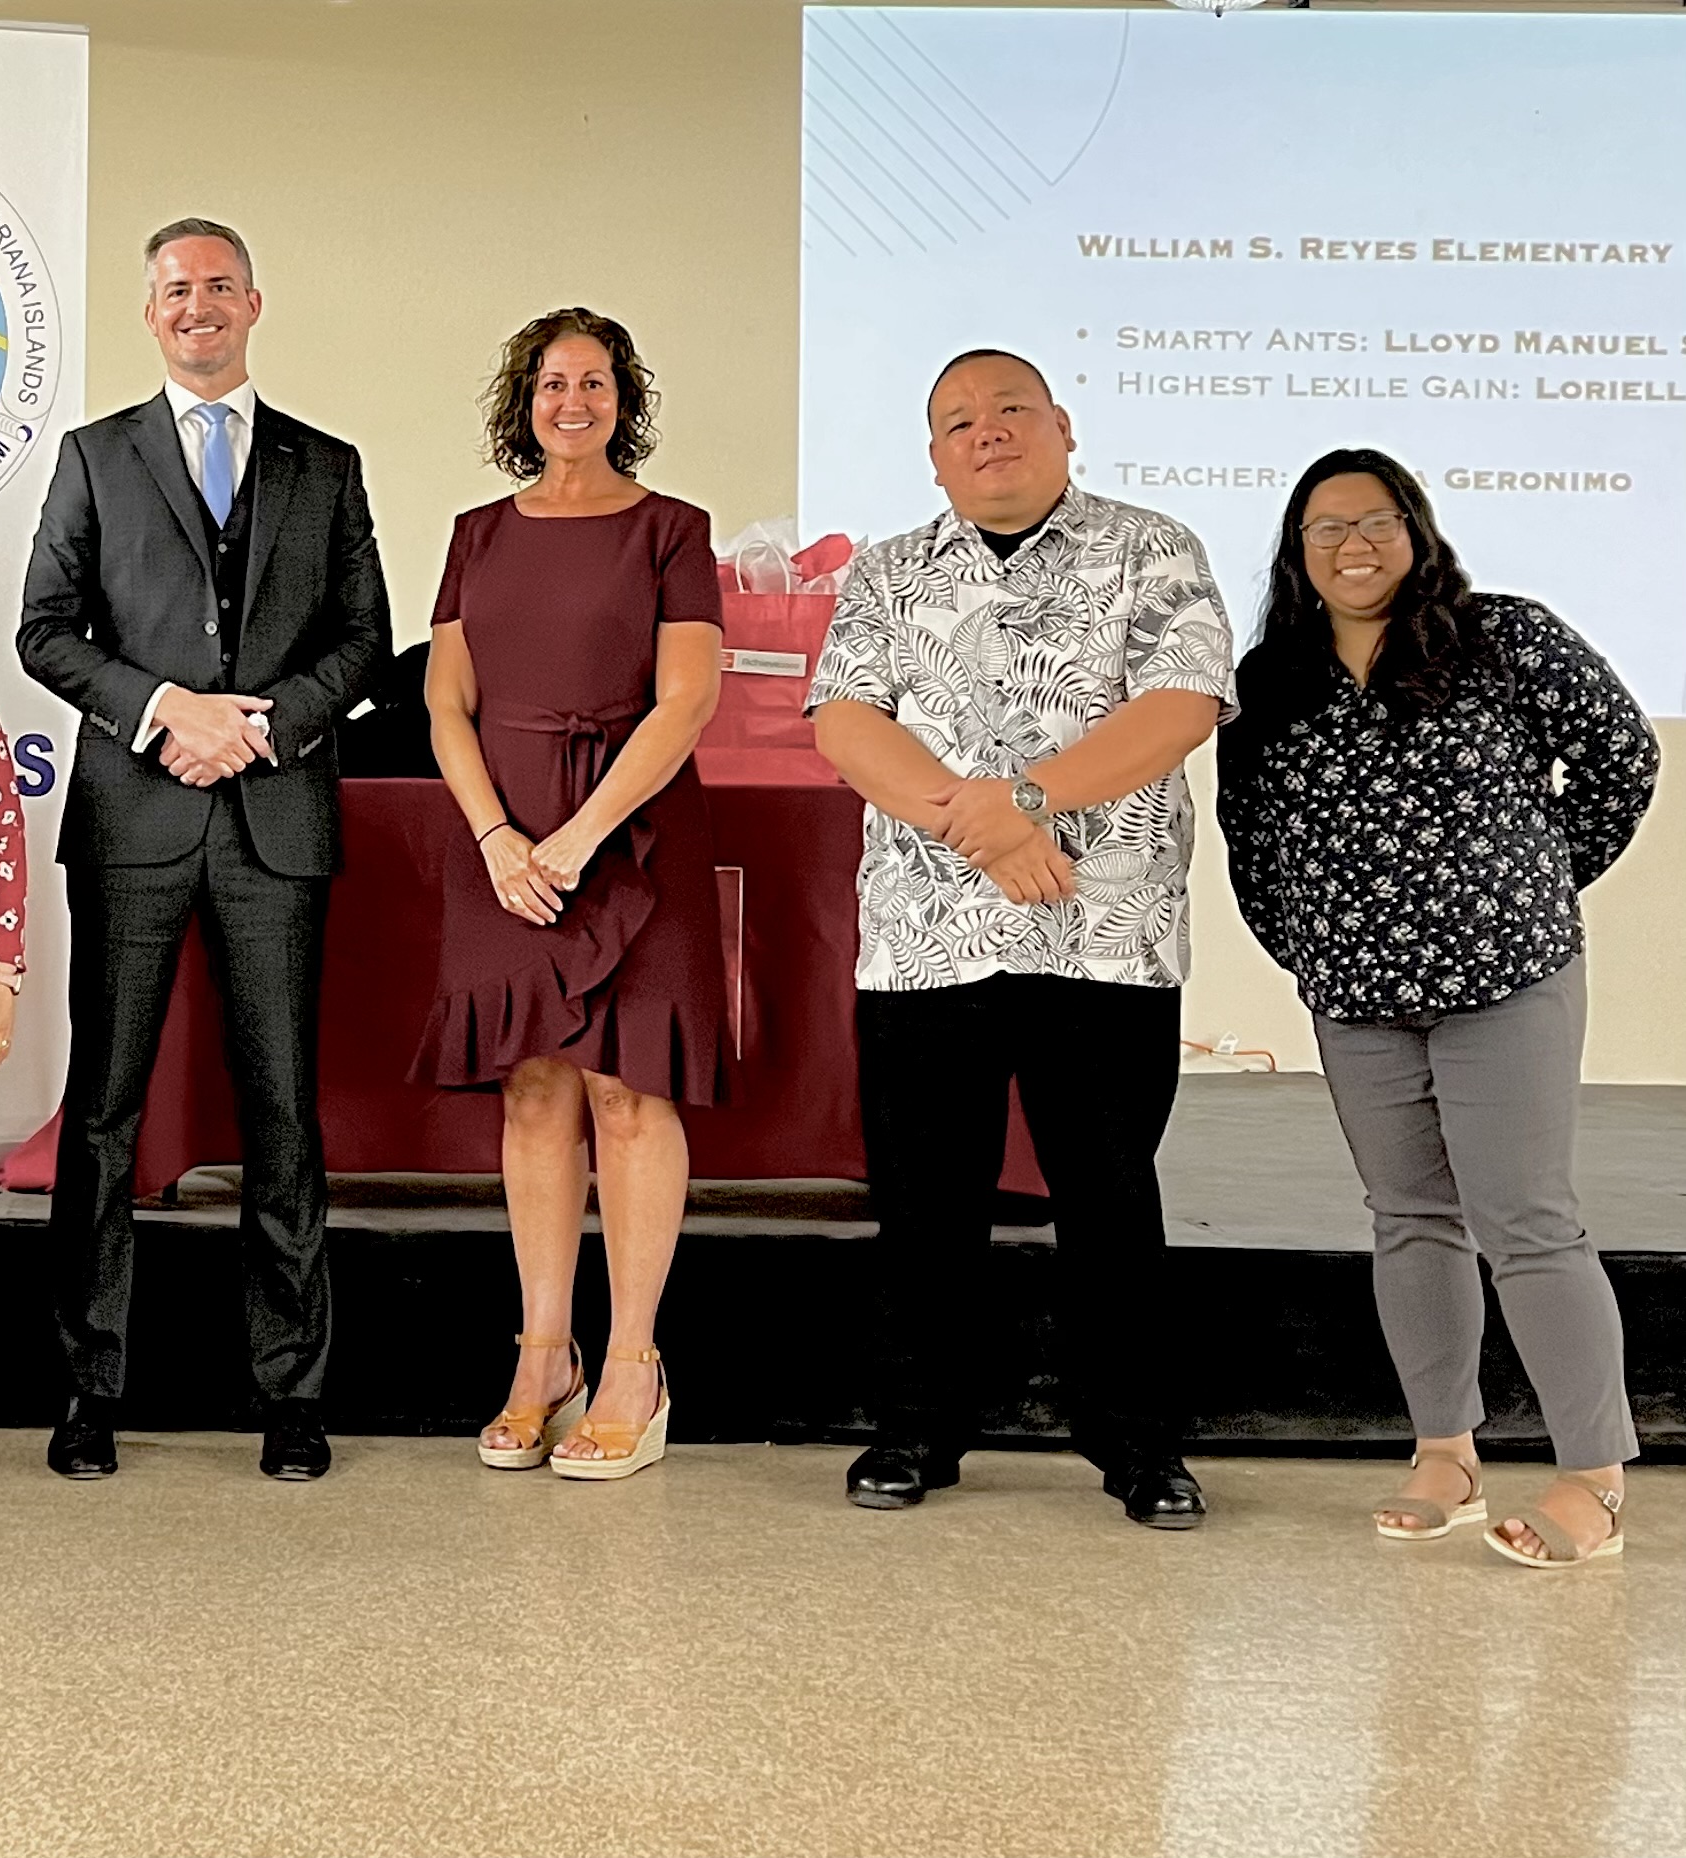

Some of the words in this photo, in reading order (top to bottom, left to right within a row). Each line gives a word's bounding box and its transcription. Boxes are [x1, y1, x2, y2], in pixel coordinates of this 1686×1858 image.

[1076, 234, 1234, 259] WILLIAM
[1248, 236, 1284, 259] S.
[1299, 237, 1418, 261] REYES
[1432, 238, 1674, 264] ELEMENTARY
[17, 301, 45, 406] ISLANDS
[1116, 326, 1253, 350] SMARTY
[1384, 330, 1501, 354] LLOYD
[1514, 330, 1668, 355] MANUEL
[1117, 371, 1273, 395] HIGHEST
[1286, 373, 1408, 398] LEXILE
[1444, 467, 1632, 492] GERONIMO
